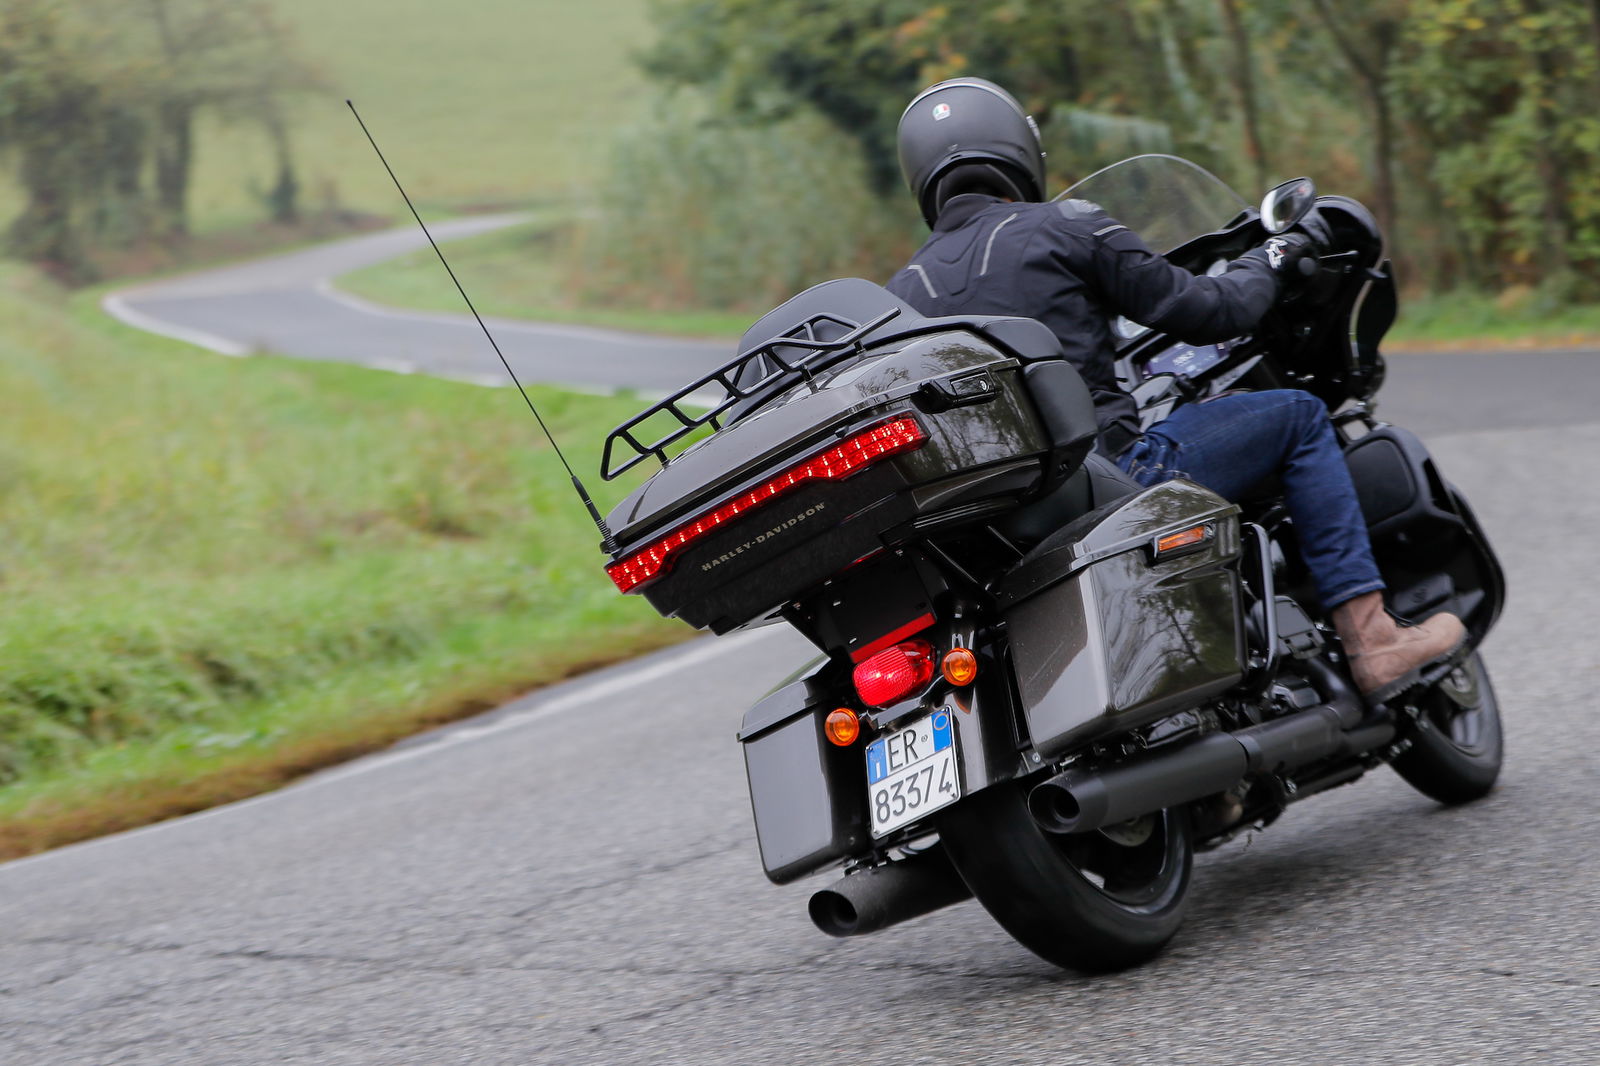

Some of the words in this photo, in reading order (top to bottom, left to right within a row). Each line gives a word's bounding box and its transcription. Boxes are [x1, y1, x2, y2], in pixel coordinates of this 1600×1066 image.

[702, 502, 825, 571] HARLEY-DAVIDSON
[887, 729, 919, 771] ER
[875, 757, 953, 824] 83374
